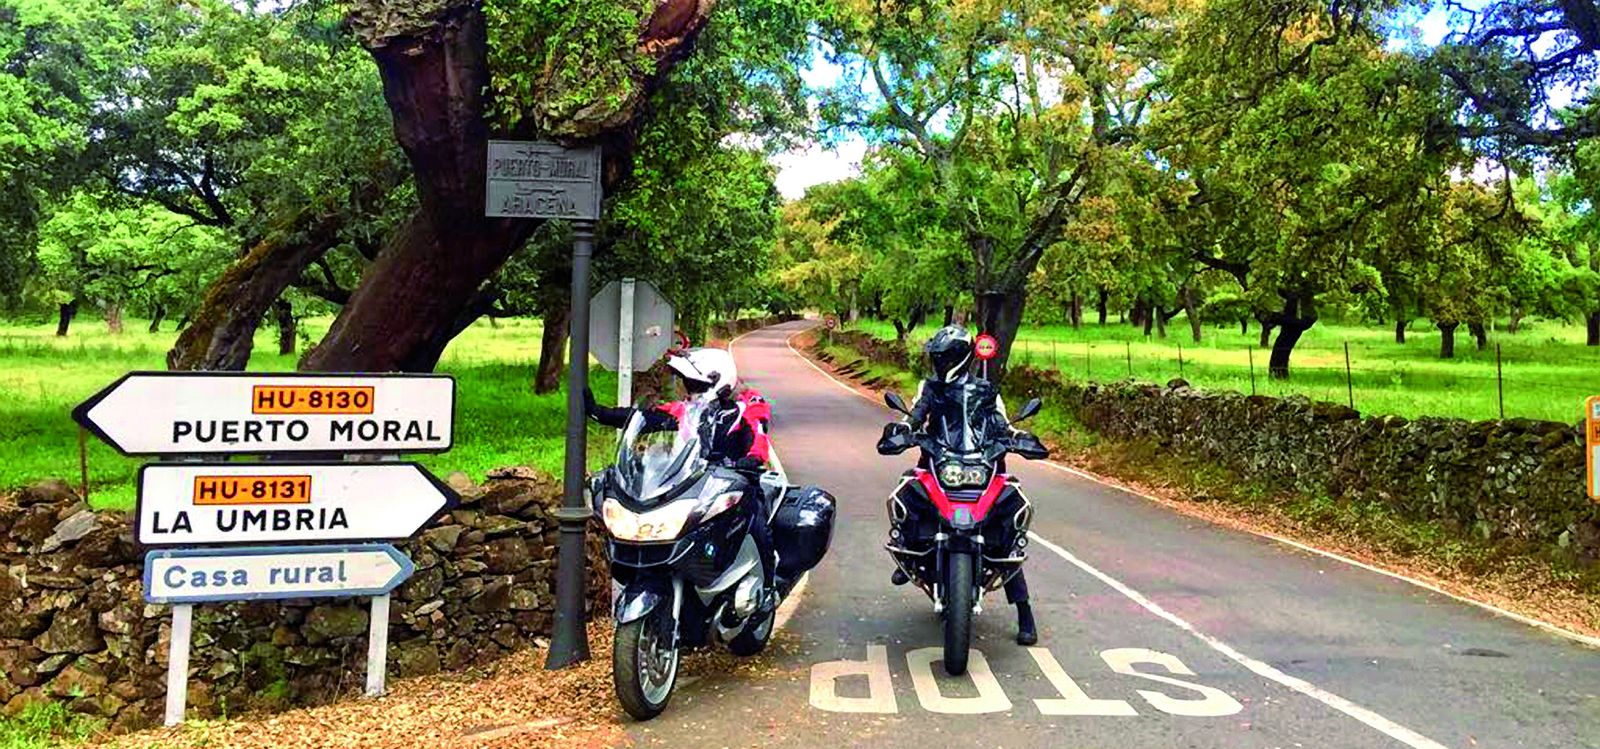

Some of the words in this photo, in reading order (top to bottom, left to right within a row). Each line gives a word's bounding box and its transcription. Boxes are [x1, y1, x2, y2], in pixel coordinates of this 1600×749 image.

[501, 196, 577, 215] ARACENA
[258, 389, 370, 410] HU-8130
[172, 419, 310, 443] PUERTO
[329, 418, 442, 442] MORAL
[199, 479, 307, 501] HU-8131
[152, 509, 193, 534] LA
[216, 507, 349, 532] UMBRIA
[163, 565, 249, 588] Casa
[269, 560, 348, 585] rural
[808, 644, 1244, 717] STOP
